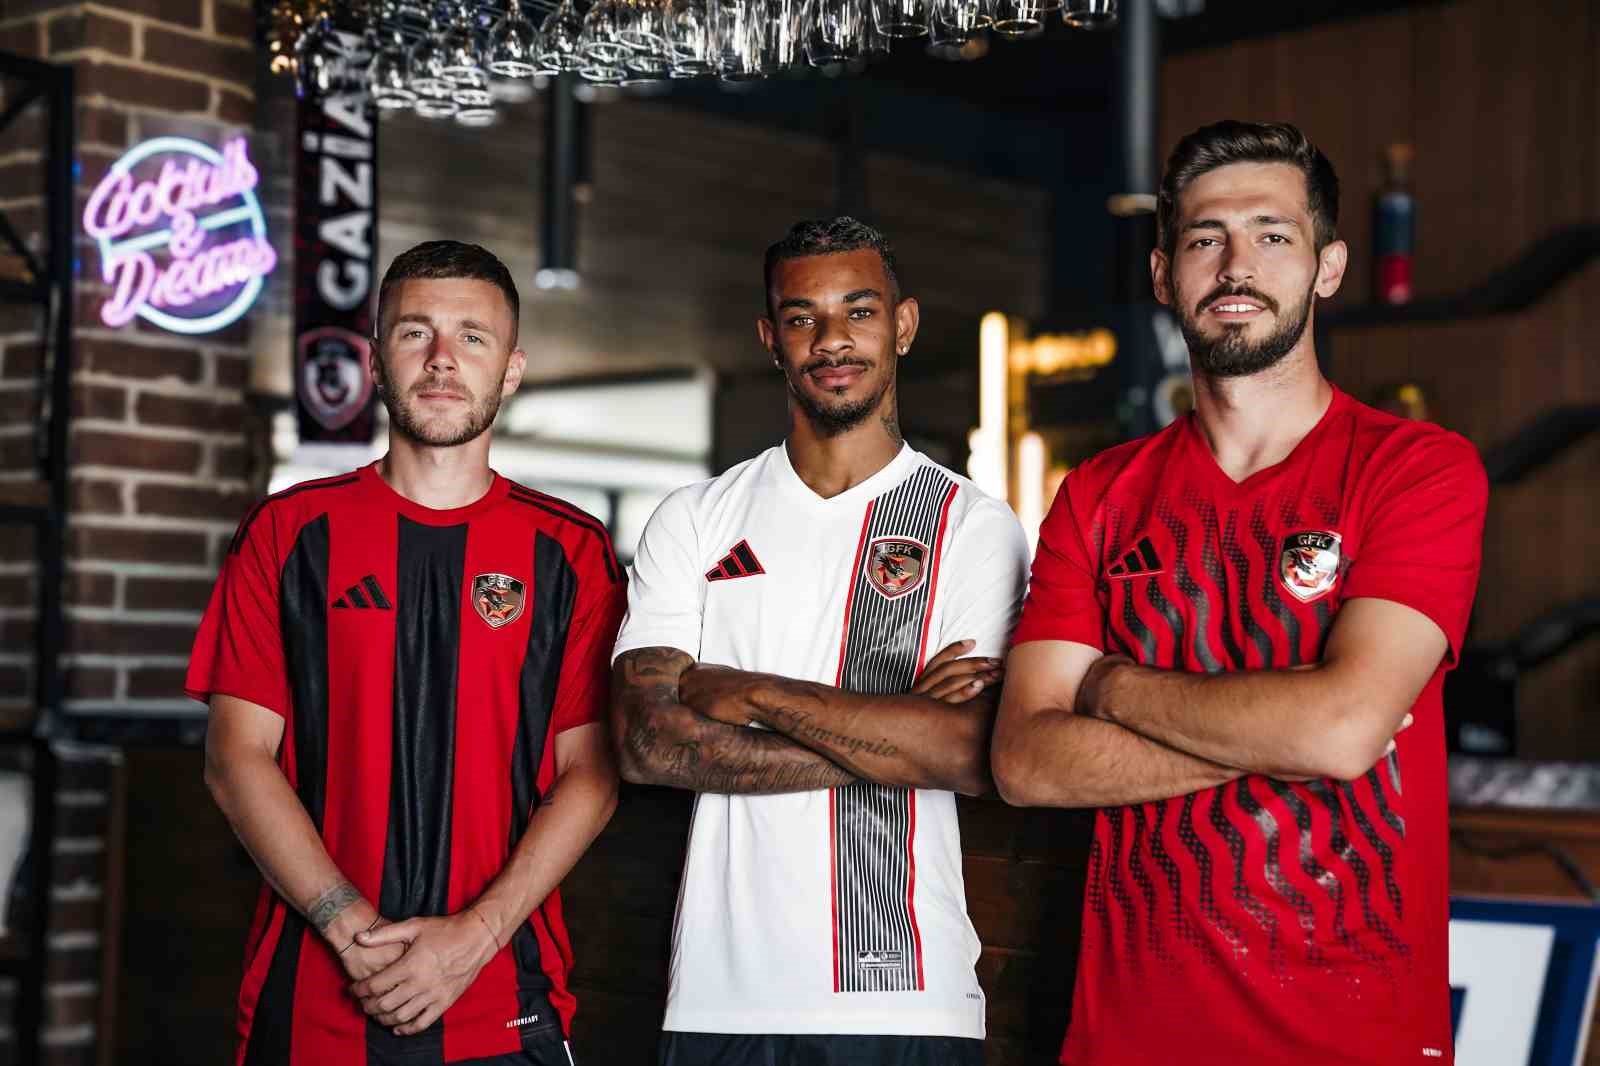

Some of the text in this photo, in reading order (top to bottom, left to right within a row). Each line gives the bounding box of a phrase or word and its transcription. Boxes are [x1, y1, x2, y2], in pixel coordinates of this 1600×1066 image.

[168, 209, 206, 259] &
[101, 237, 278, 327] Dreams
[887, 543, 914, 555] GFK
[1297, 534, 1331, 548] GFK
